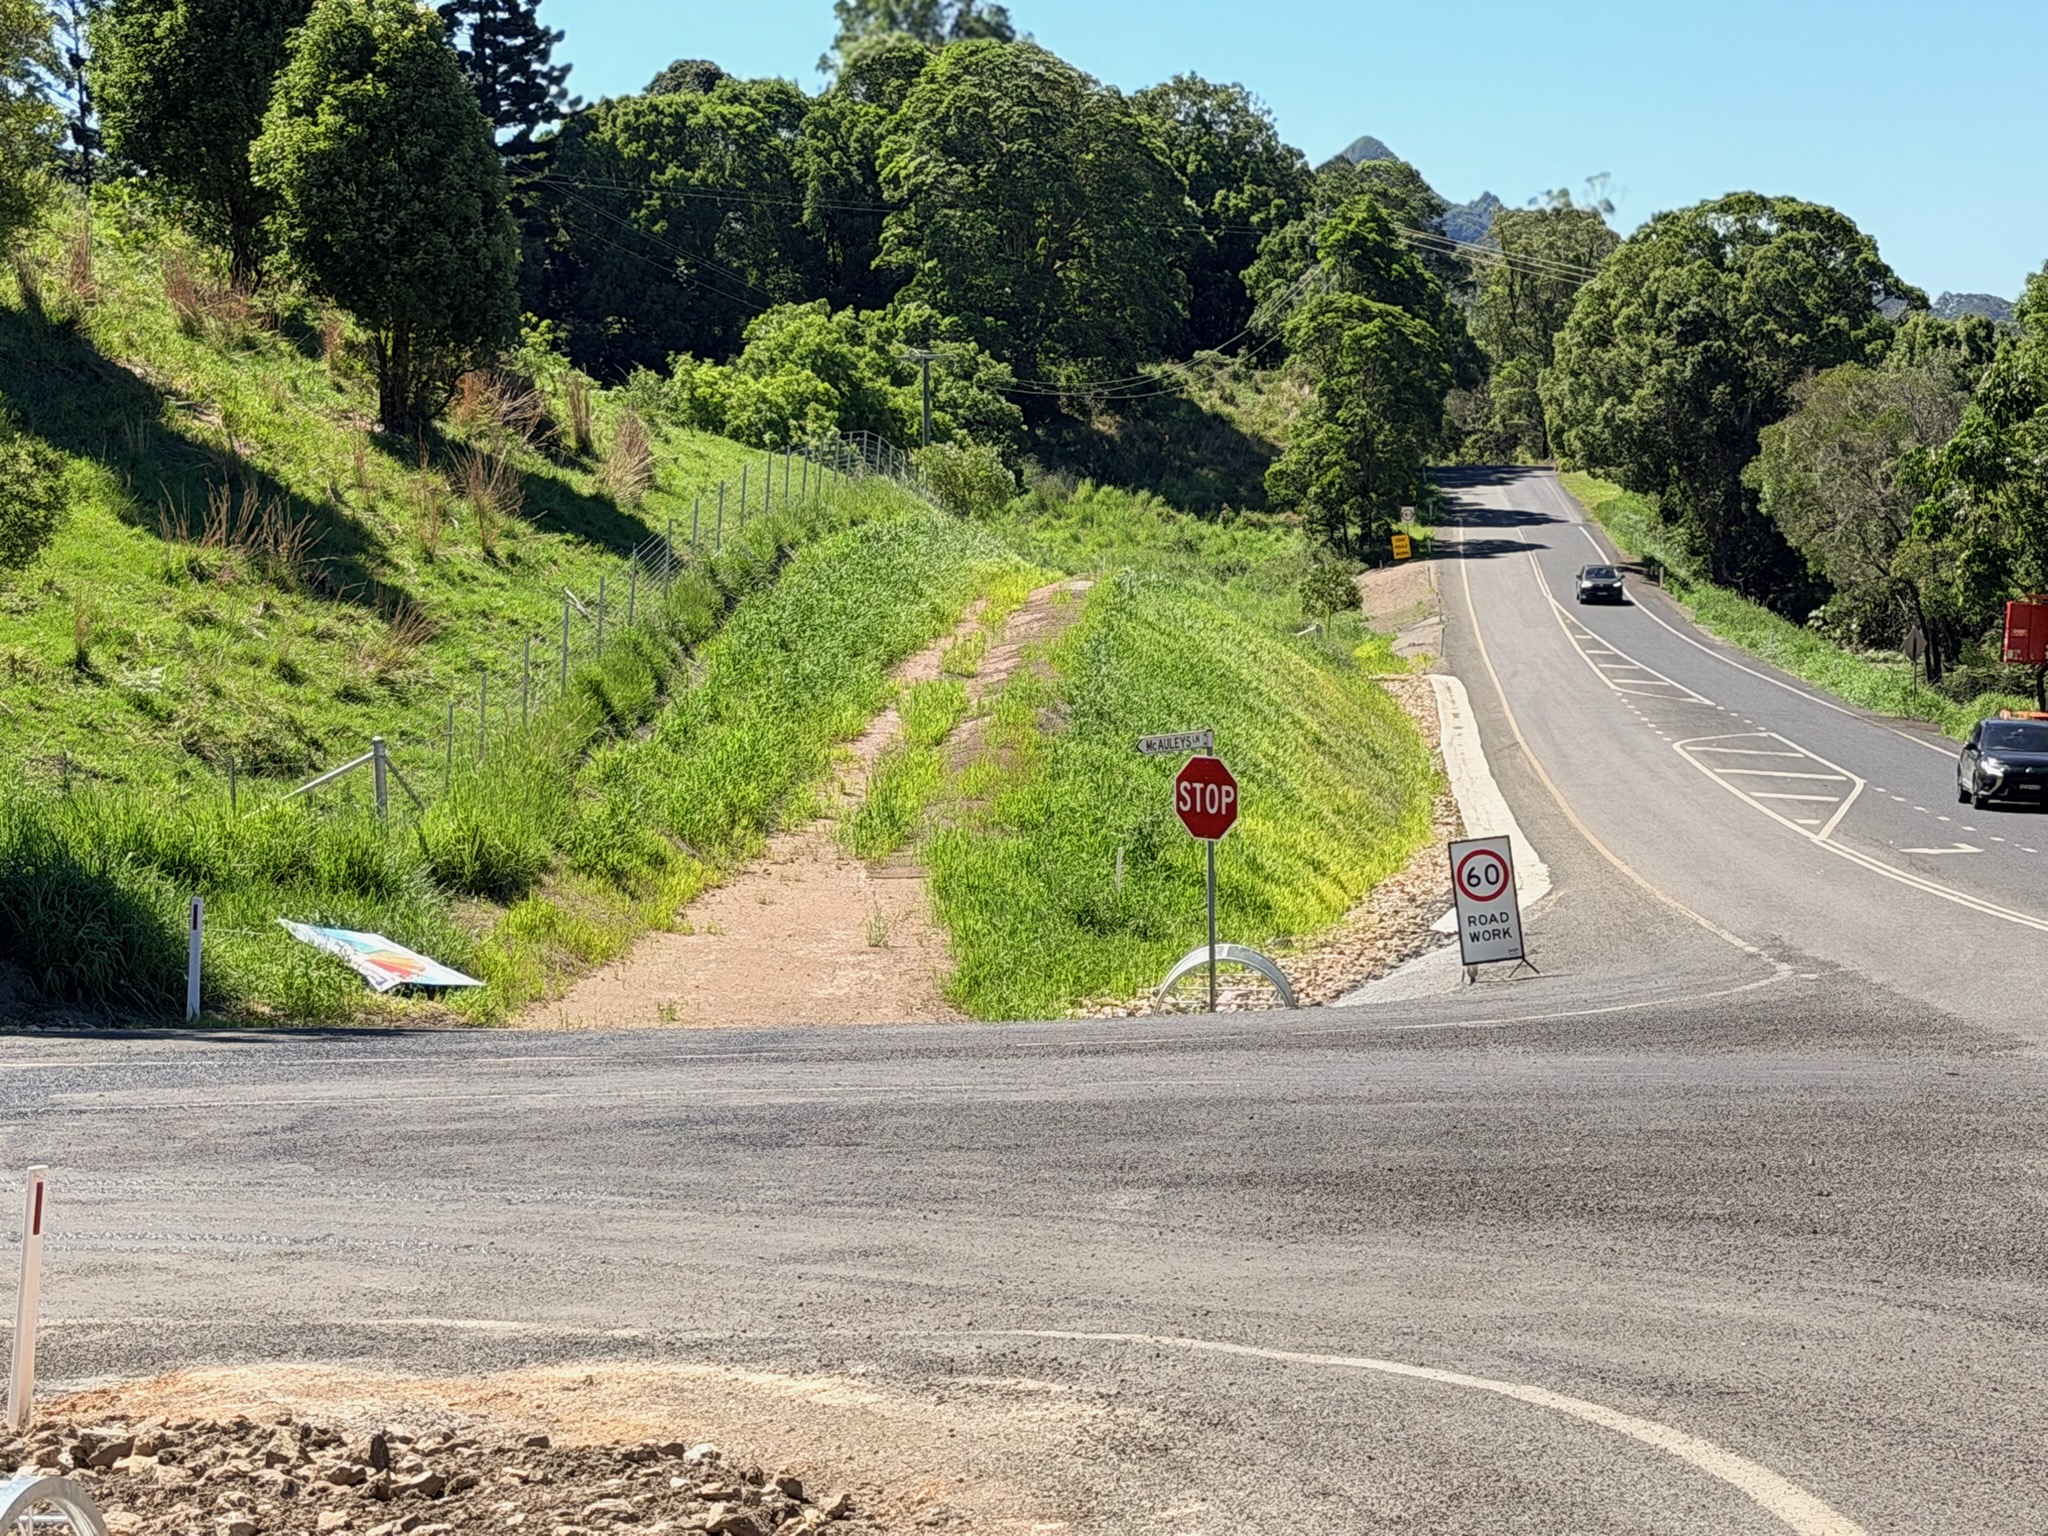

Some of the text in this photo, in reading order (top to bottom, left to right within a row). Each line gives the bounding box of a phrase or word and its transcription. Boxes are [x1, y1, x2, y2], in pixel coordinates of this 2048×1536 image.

[1179, 781, 1235, 815] STOP
[1466, 863, 1500, 888] 60
[1467, 911, 1510, 927] ROAD
[1469, 927, 1513, 943] WORK
